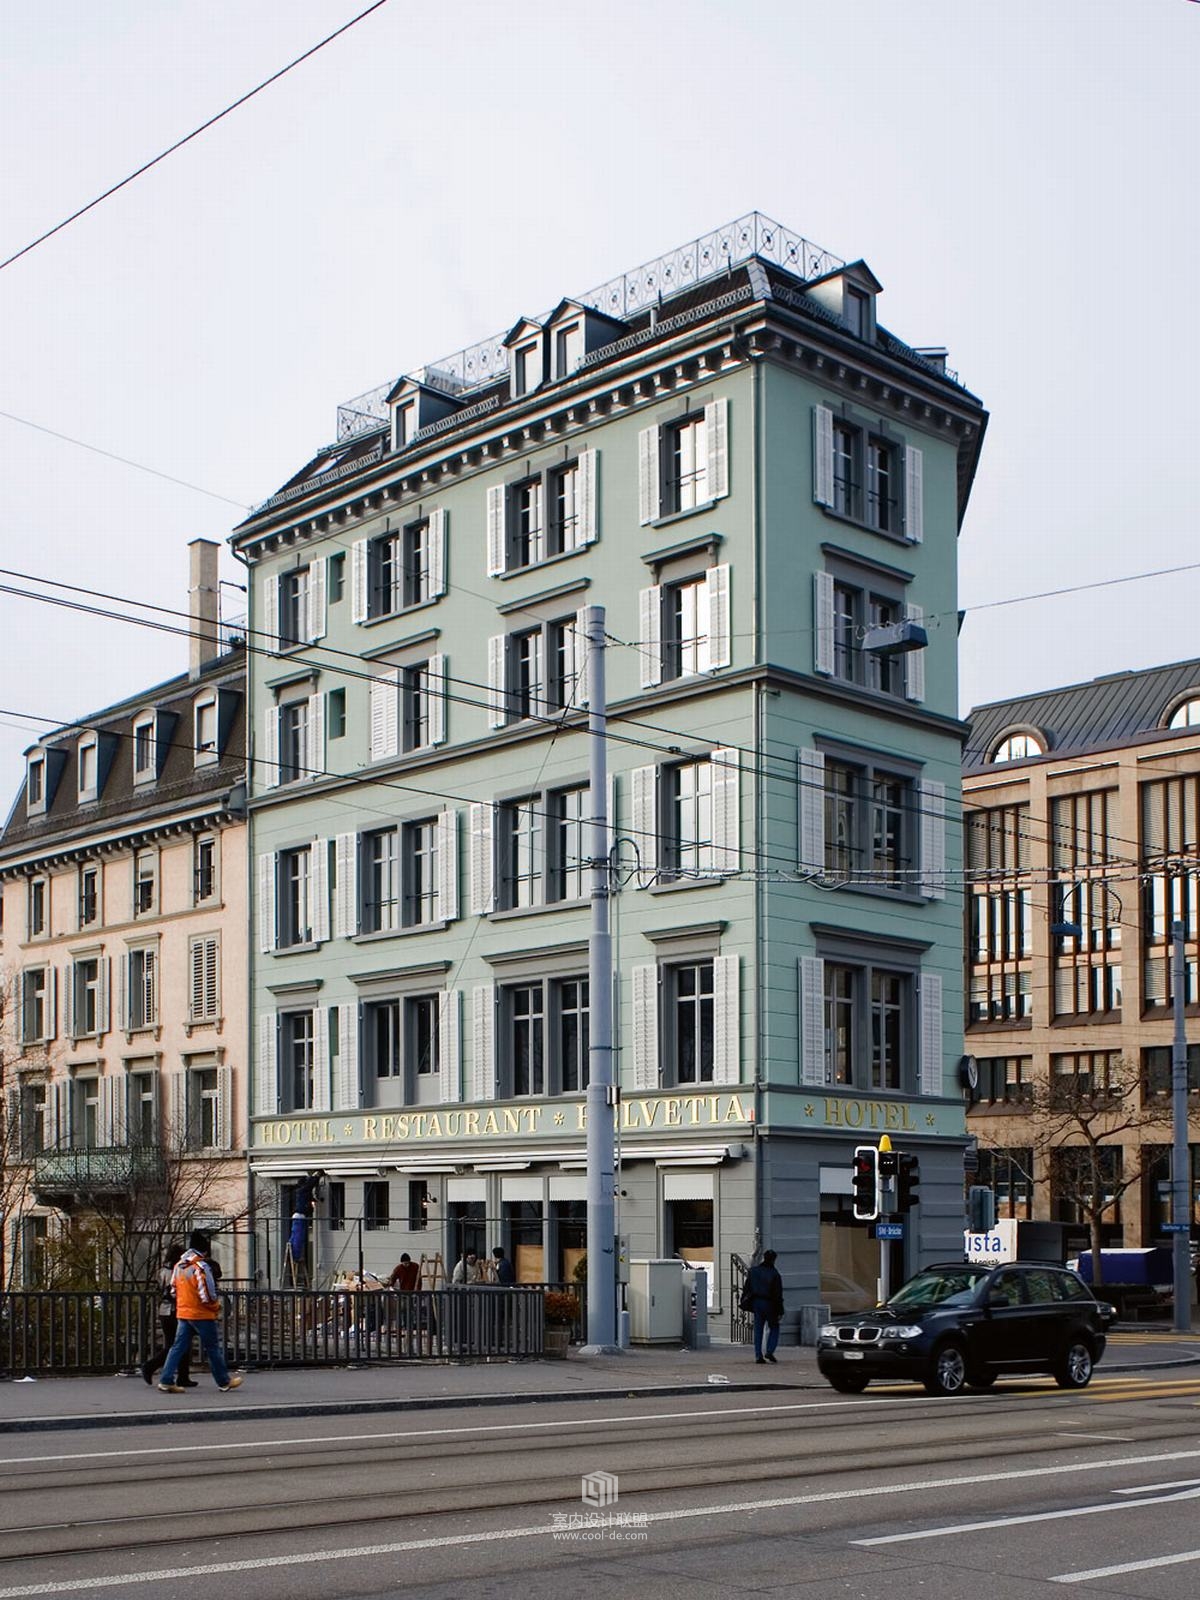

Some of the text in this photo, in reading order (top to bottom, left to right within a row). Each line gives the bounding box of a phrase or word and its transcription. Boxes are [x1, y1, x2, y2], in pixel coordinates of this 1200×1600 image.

[261, 1095, 746, 1145] HOTEL RESTAURANT HLVETIA
[823, 1097, 916, 1131] HOTEL
[963, 1233, 1007, 1252] ista.
